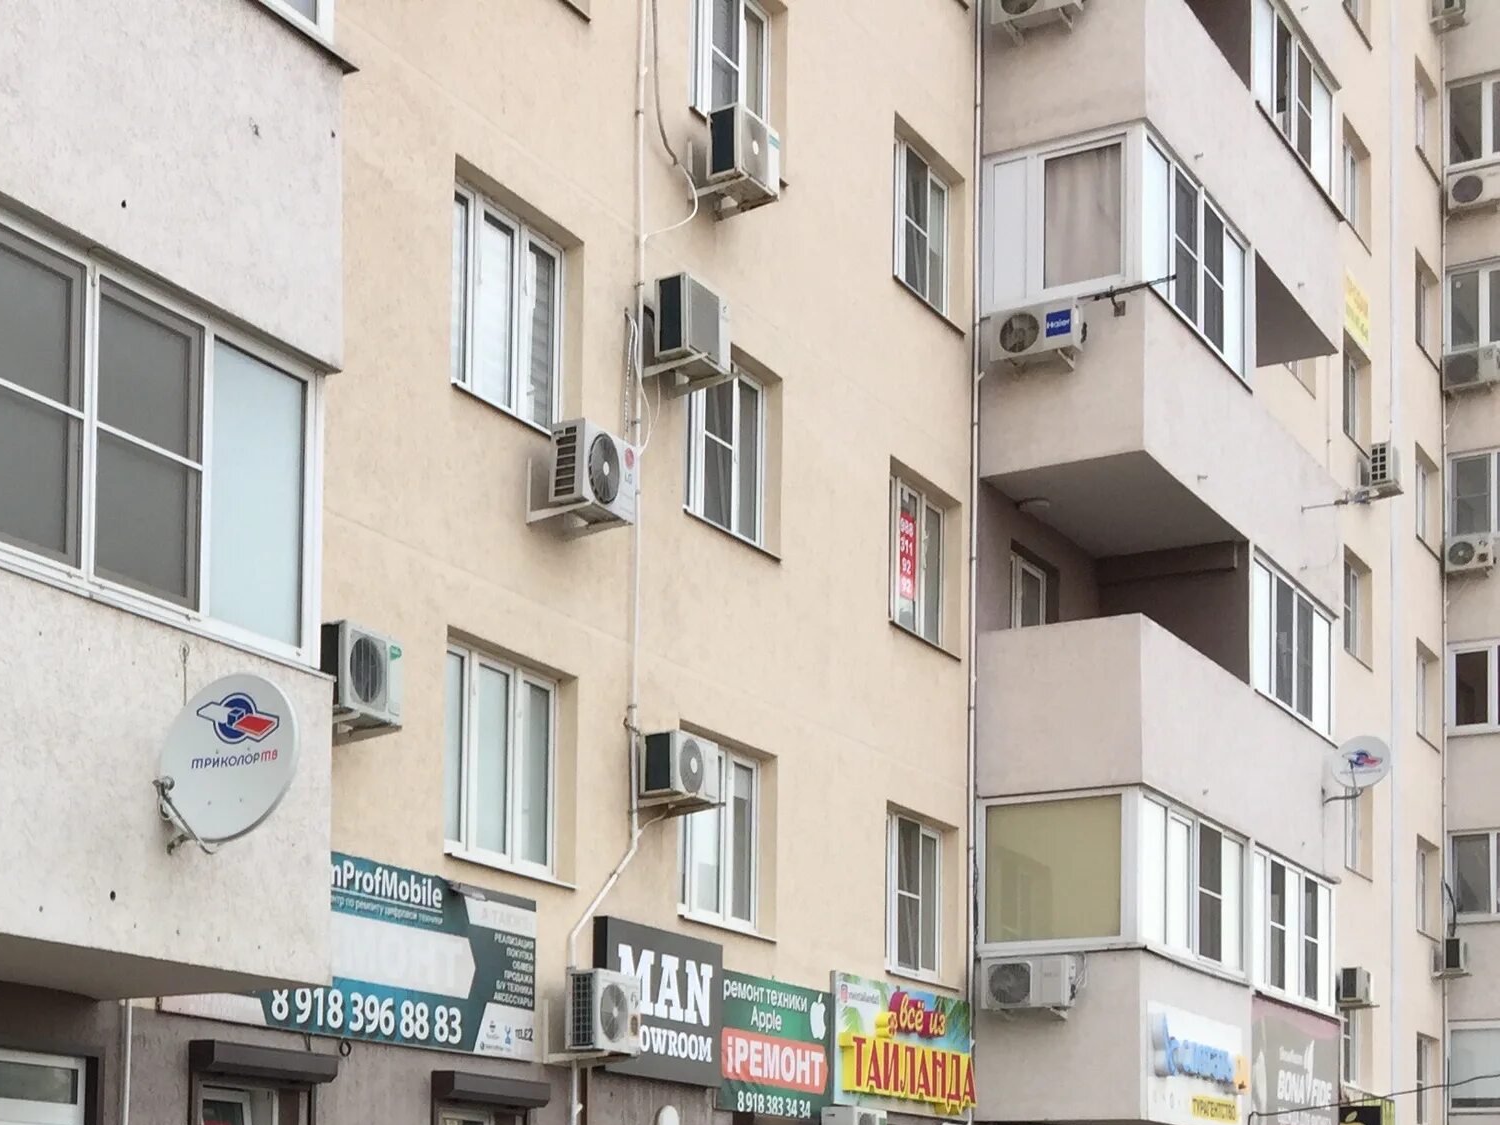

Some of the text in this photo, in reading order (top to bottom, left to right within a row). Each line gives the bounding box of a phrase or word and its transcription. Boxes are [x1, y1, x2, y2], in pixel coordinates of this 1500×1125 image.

[1046, 318, 1069, 330] Haier
[624, 472, 633, 485] LG
[494, 932, 534, 949] РЕАЛИЗАЦИЯ
[506, 948, 534, 962] ПОКУПКА
[504, 970, 533, 984] ПРОДАЖА
[512, 960, 534, 973] ОБМЕН
[505, 982, 533, 996] ТЕХНИКА
[618, 943, 713, 1027] MAN
[723, 978, 808, 1014] ремонт техники
[493, 993, 533, 1008] АКСЕССУАРЫ
[270, 988, 462, 1045] 8 918 396 88 83
[750, 1005, 782, 1033] Apple
[900, 993, 925, 1032] всё
[929, 1011, 946, 1036] из
[515, 1027, 534, 1042] TELE2
[640, 1024, 713, 1063] OWROOM
[726, 1034, 825, 1088] iРЕМОНТ
[1277, 1069, 1306, 1105] BONA
[737, 1091, 811, 1120] 8 918 383 34 34
